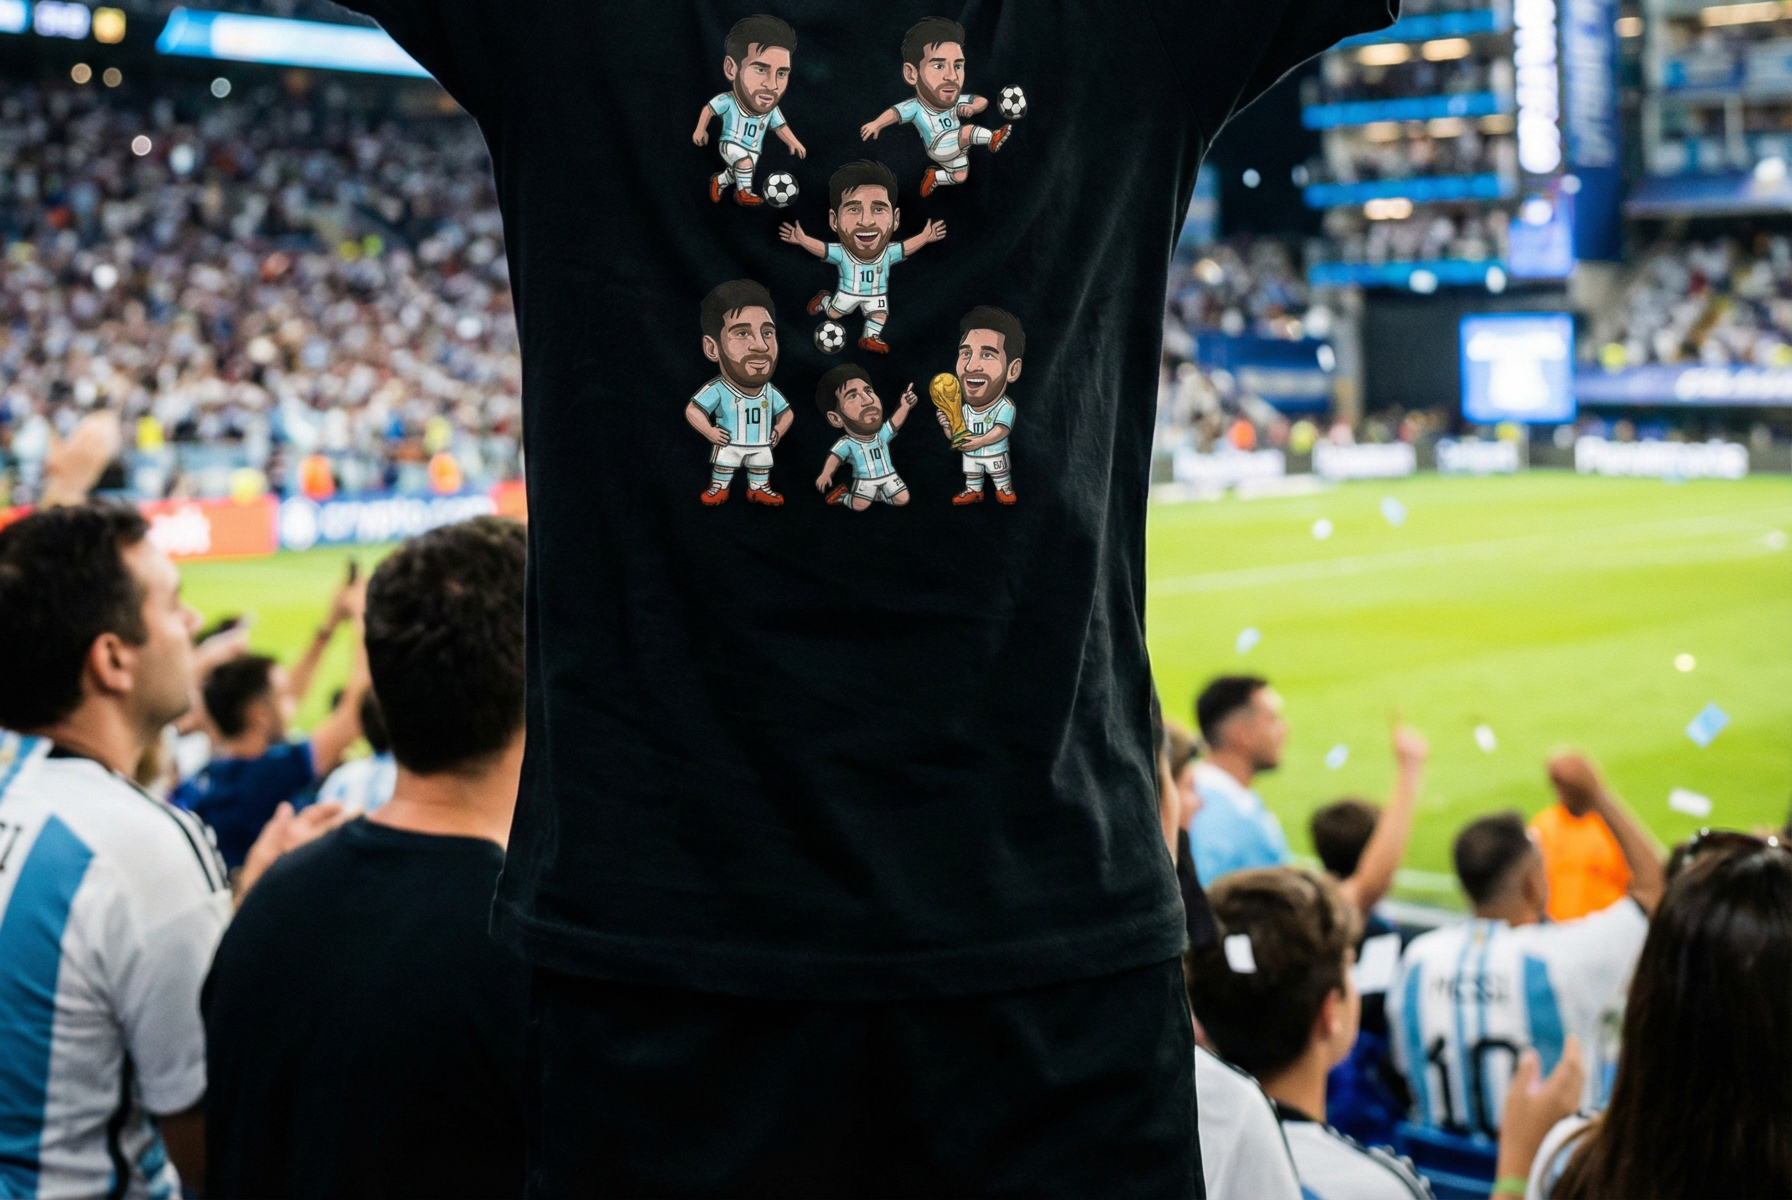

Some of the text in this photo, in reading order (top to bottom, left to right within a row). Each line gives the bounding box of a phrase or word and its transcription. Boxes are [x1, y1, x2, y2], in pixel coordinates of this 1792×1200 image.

[744, 121, 758, 138] 10
[939, 117, 953, 131] 10
[860, 269, 875, 284] 10
[745, 407, 761, 425] 10
[869, 447, 882, 461] 10
[1426, 1035, 1523, 1140] 10
